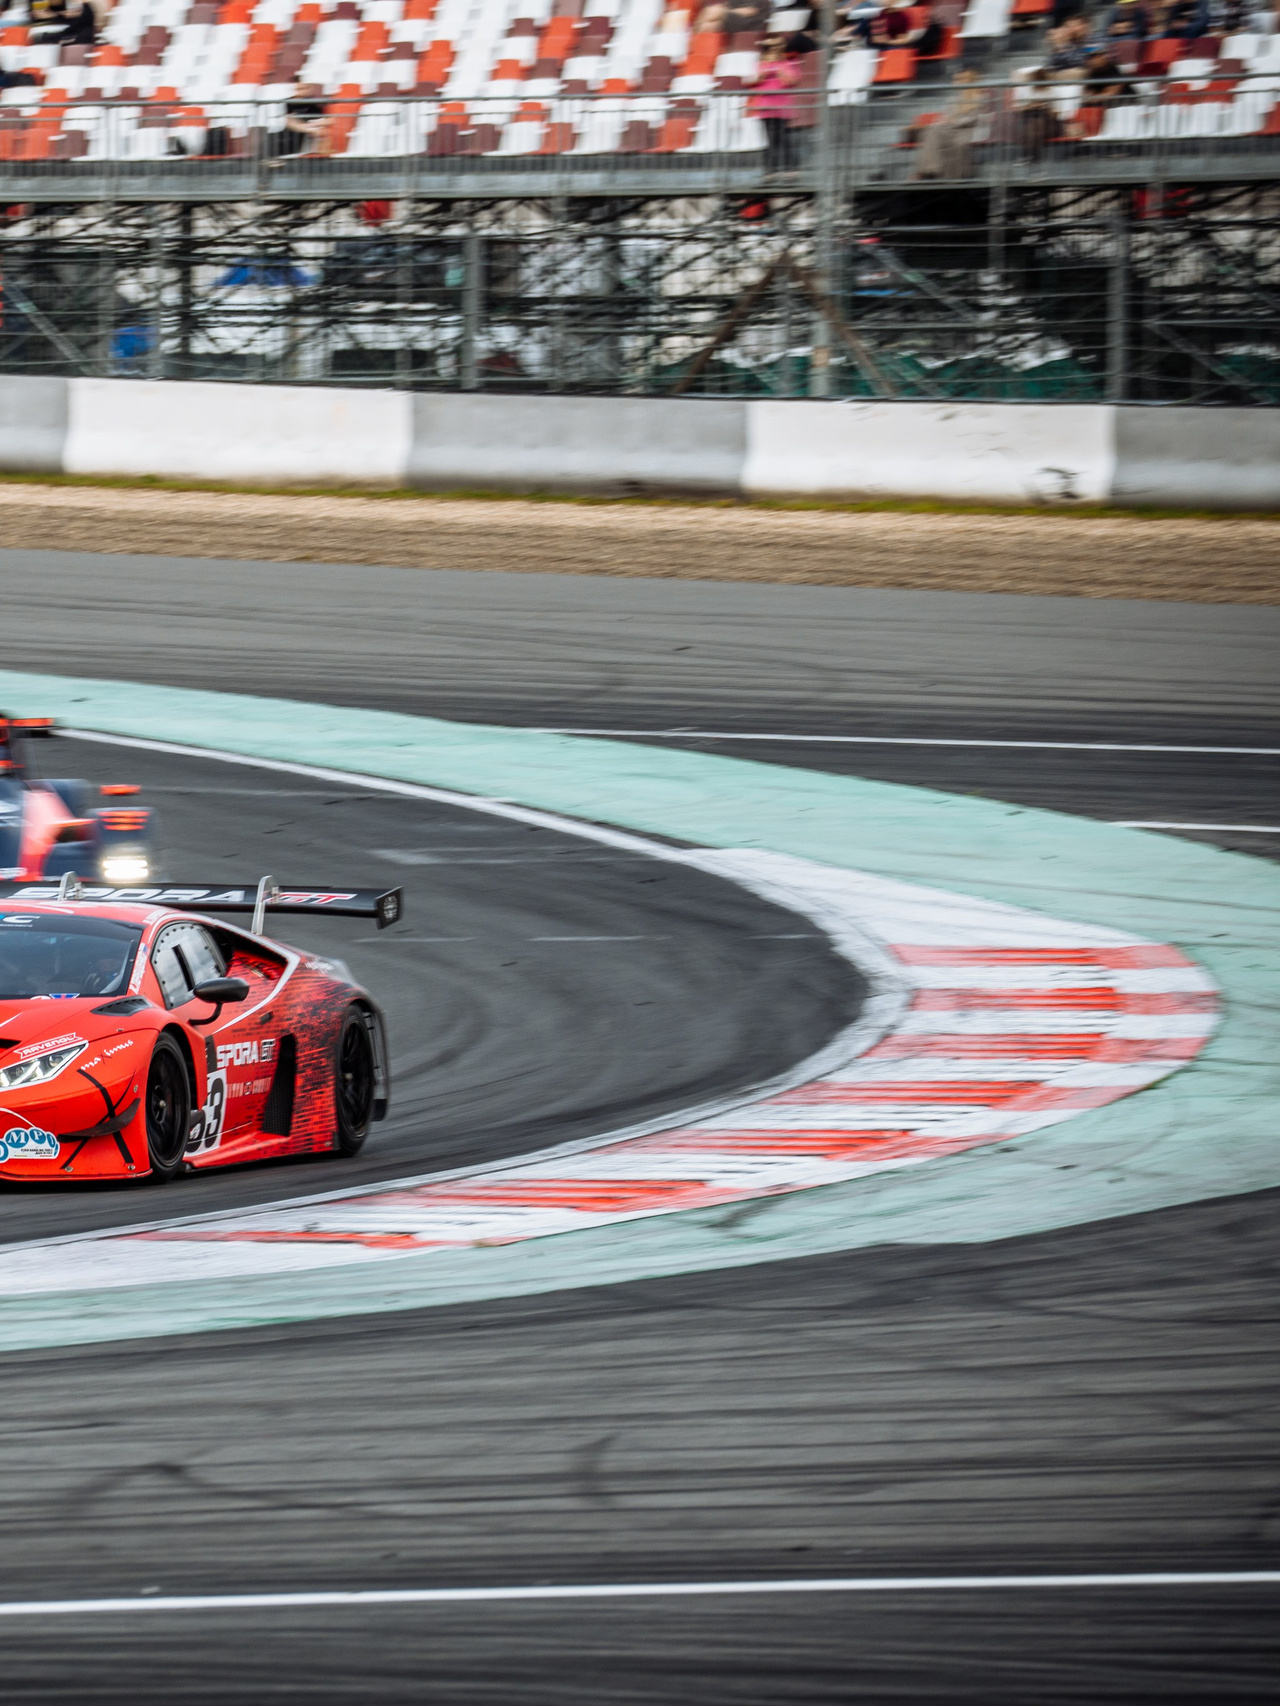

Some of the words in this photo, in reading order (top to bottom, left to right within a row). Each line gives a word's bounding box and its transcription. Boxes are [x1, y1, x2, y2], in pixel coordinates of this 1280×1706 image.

[7, 885, 245, 902] SPORA
[22, 1036, 76, 1056] RAVENOL
[216, 1041, 259, 1069] SPORA
